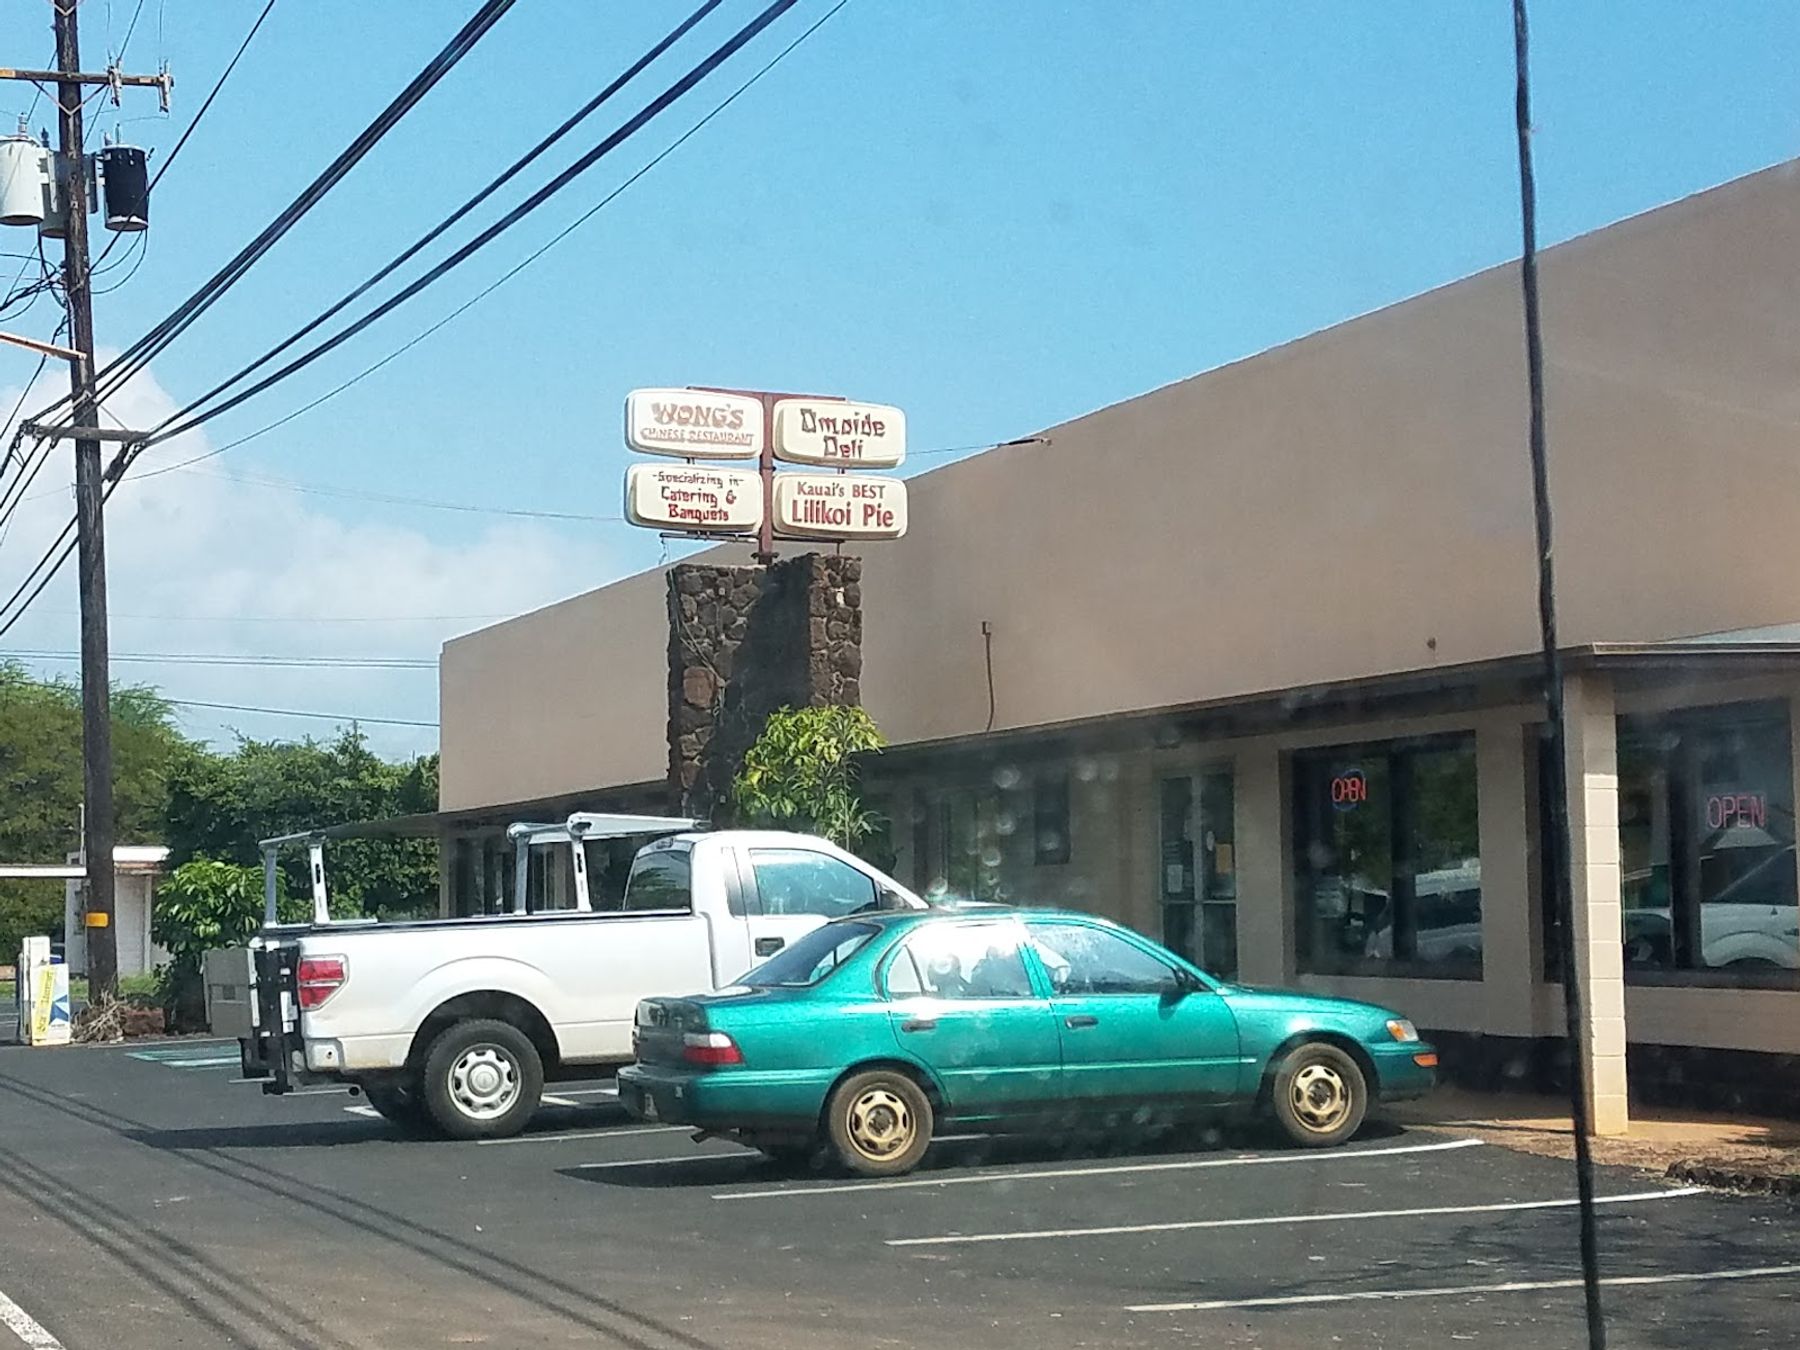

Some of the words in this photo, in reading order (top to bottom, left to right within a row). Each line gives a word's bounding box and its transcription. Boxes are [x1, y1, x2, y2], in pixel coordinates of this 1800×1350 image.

[651, 402, 744, 430] WONG'S
[800, 408, 886, 437] Omoide
[640, 427, 685, 443] CHINESE
[687, 429, 755, 447] RESTAURANT
[823, 435, 864, 459] Deli
[661, 486, 718, 508] Catering
[725, 489, 737, 505] &
[797, 481, 845, 498] Kauai's
[852, 484, 886, 499] BEST
[668, 503, 730, 523] Banquets
[792, 499, 852, 525] Lilikoi
[863, 503, 894, 527] Pie
[1331, 777, 1366, 802] OPEN
[1707, 796, 1766, 829] OPEN
